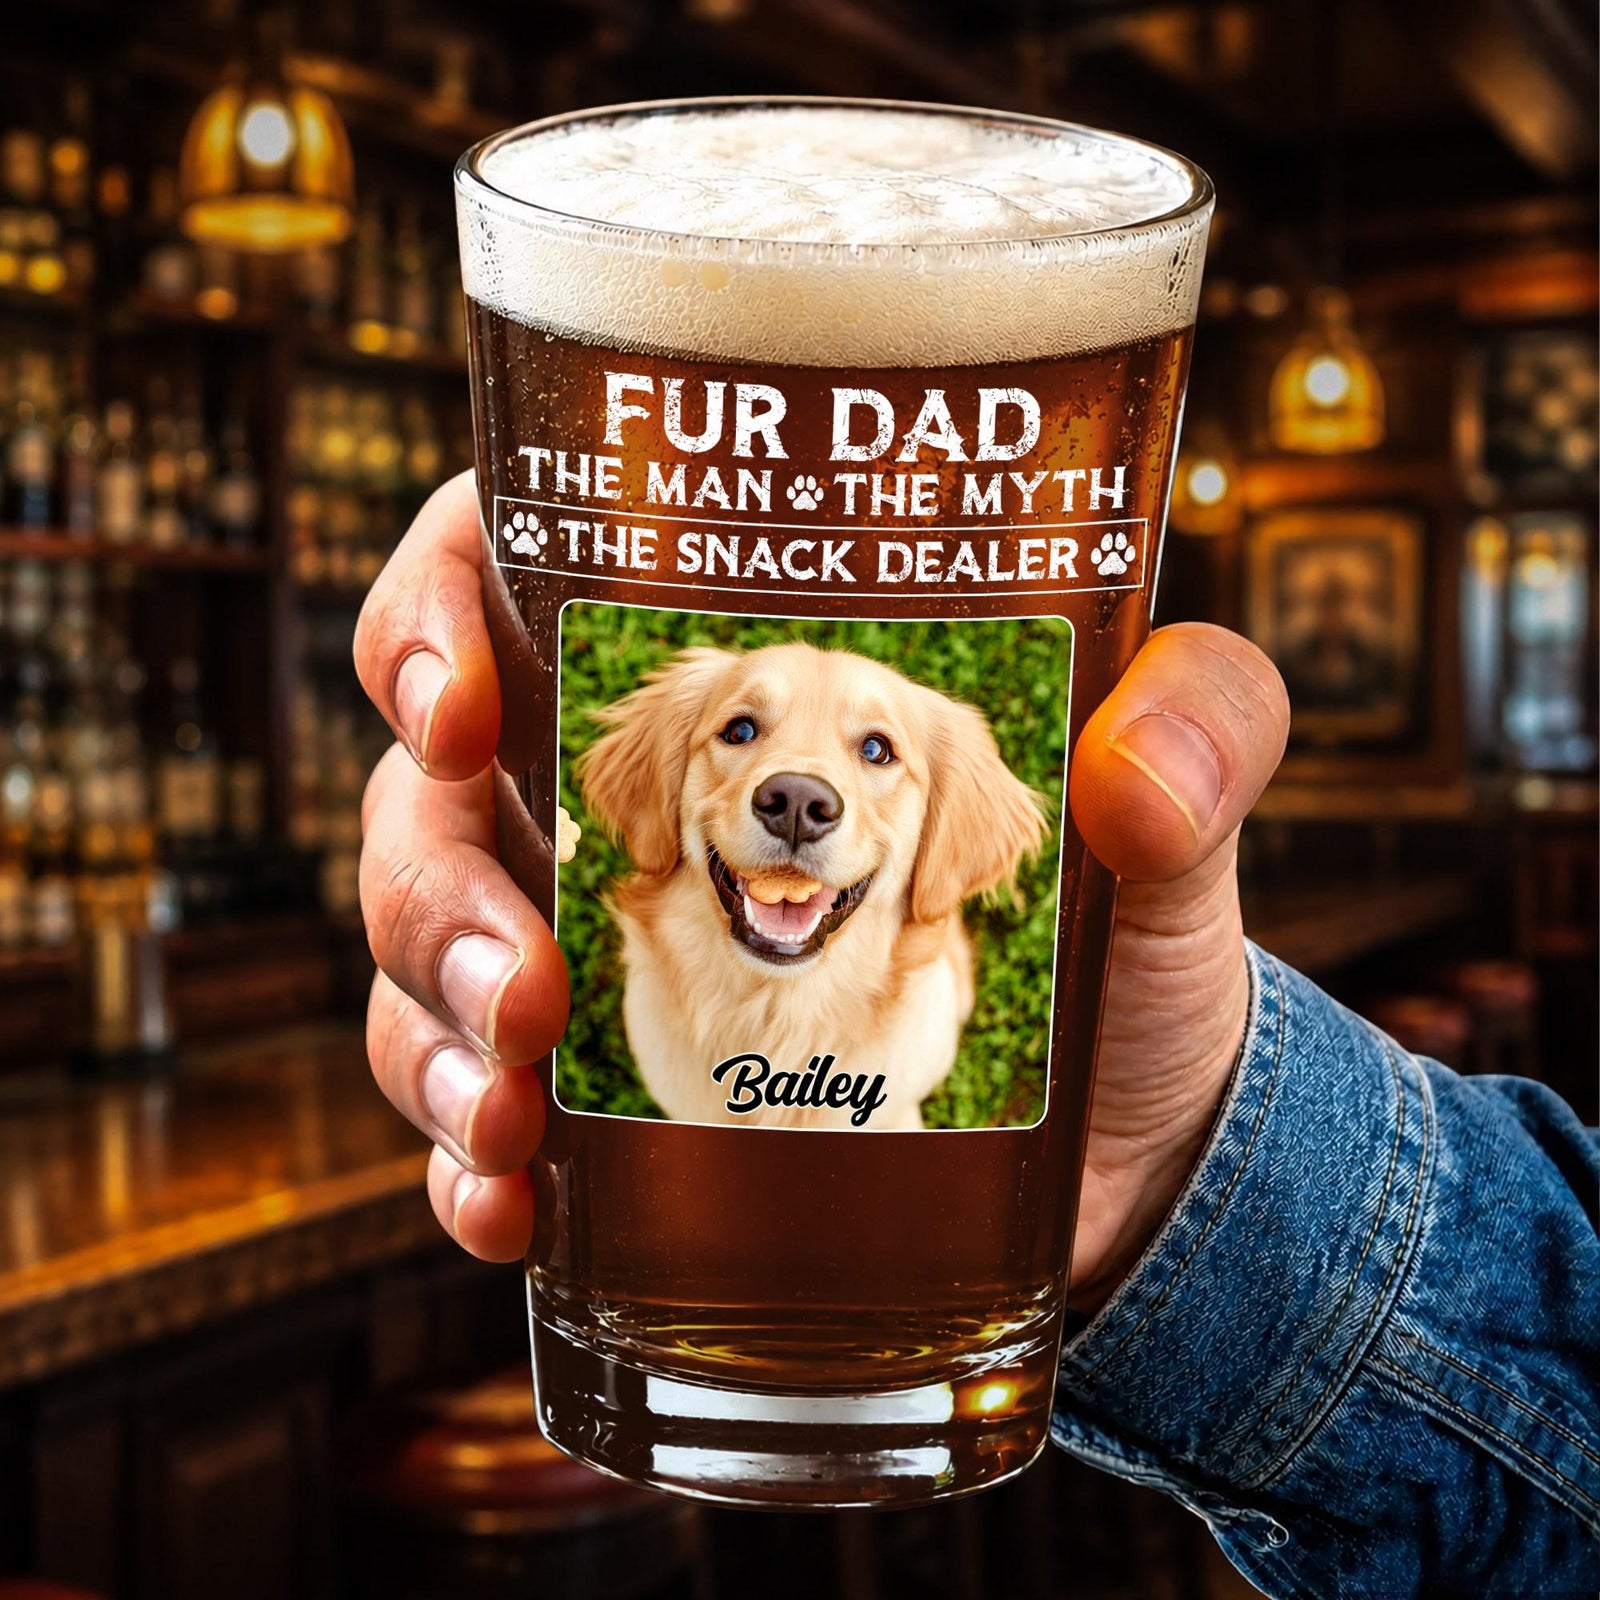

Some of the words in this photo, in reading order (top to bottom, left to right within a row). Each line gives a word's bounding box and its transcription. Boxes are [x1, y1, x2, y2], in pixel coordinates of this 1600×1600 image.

[603, 371, 790, 460] FUR
[829, 387, 1041, 463] DAD
[518, 445, 623, 499] THE
[647, 461, 773, 513] MAN
[834, 472, 940, 517] THE
[960, 466, 1126, 515] MYTH
[557, 518, 658, 571] THE
[677, 531, 857, 583] SNACK
[876, 537, 1079, 584] DEALER
[712, 1053, 888, 1127] Bailey
